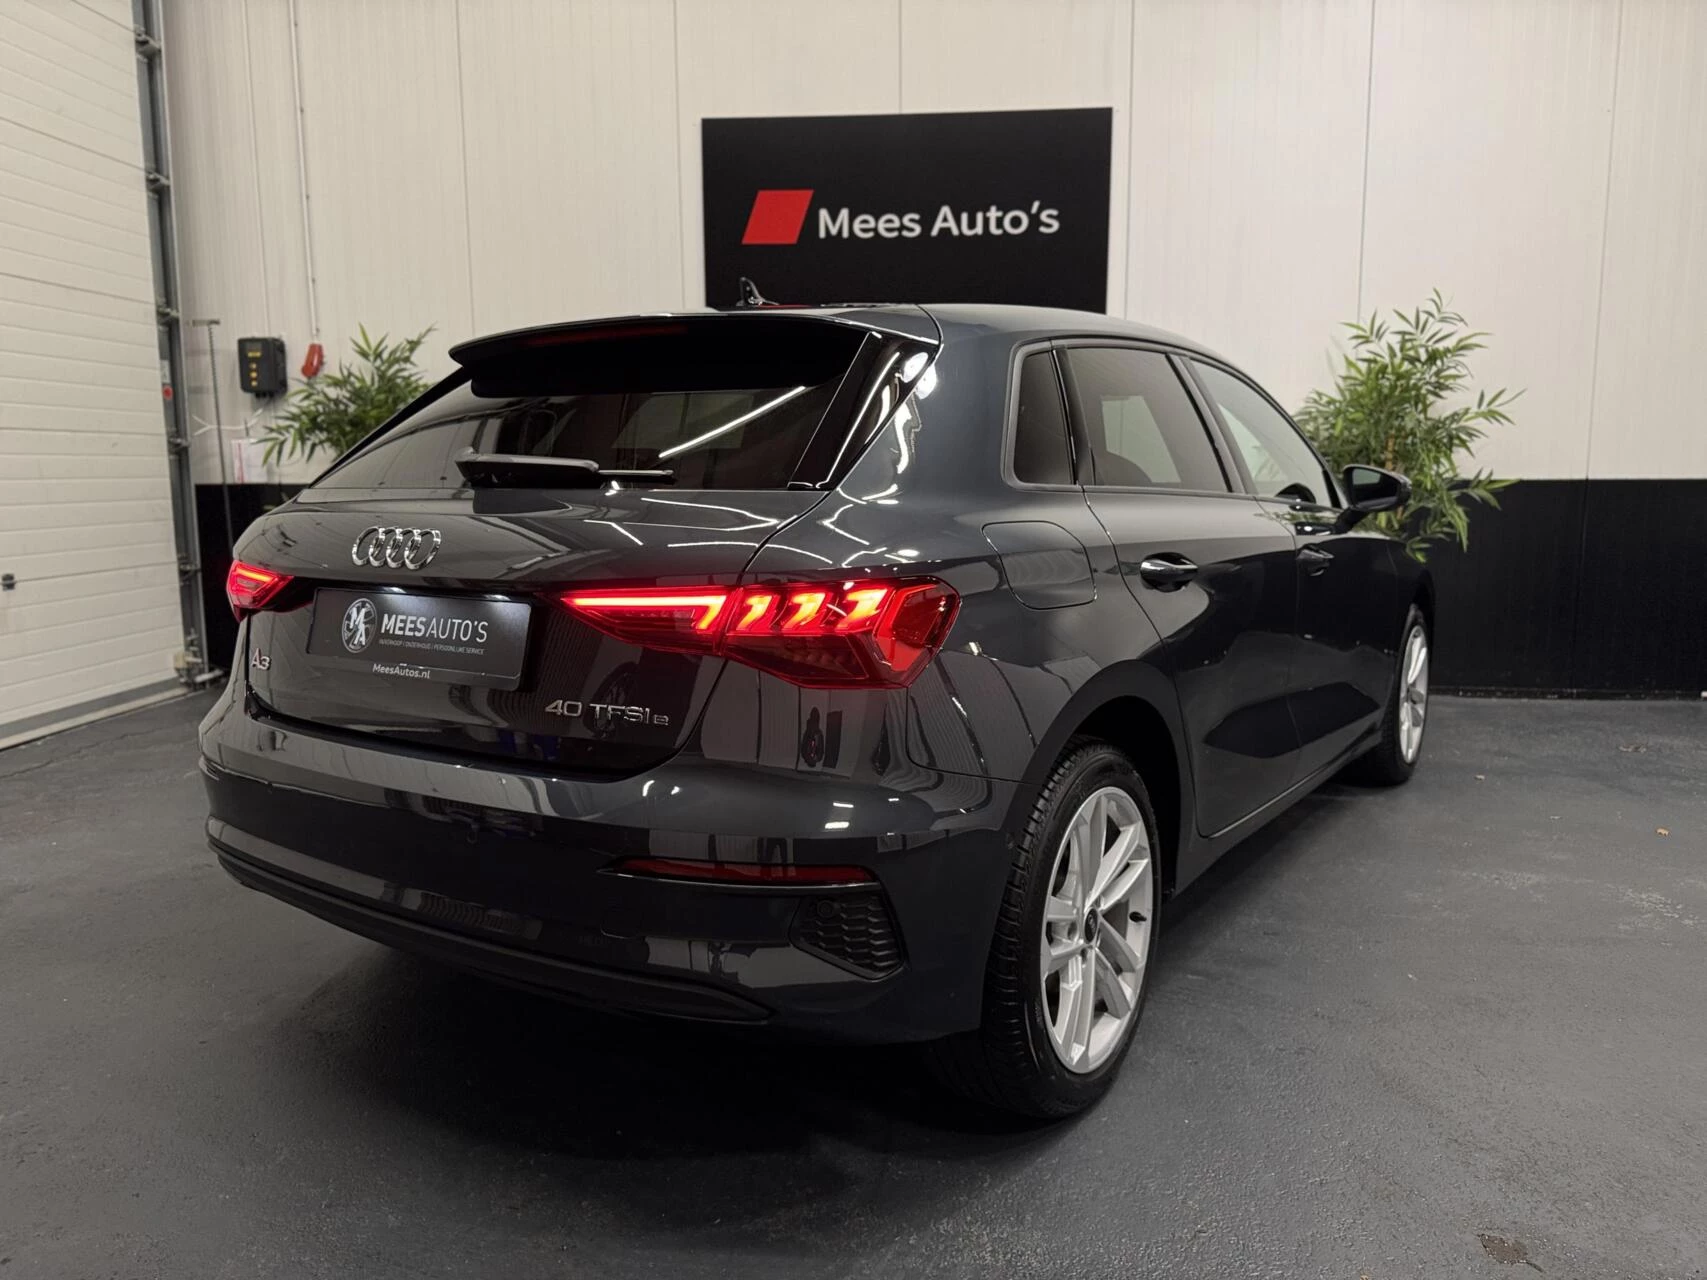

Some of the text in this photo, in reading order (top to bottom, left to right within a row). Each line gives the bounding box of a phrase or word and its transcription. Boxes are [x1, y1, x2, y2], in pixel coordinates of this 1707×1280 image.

[818, 200, 1060, 238] Mees Auto's
[250, 647, 271, 671] A3
[372, 663, 431, 679] MeesAutos.nl
[544, 699, 583, 718] 40
